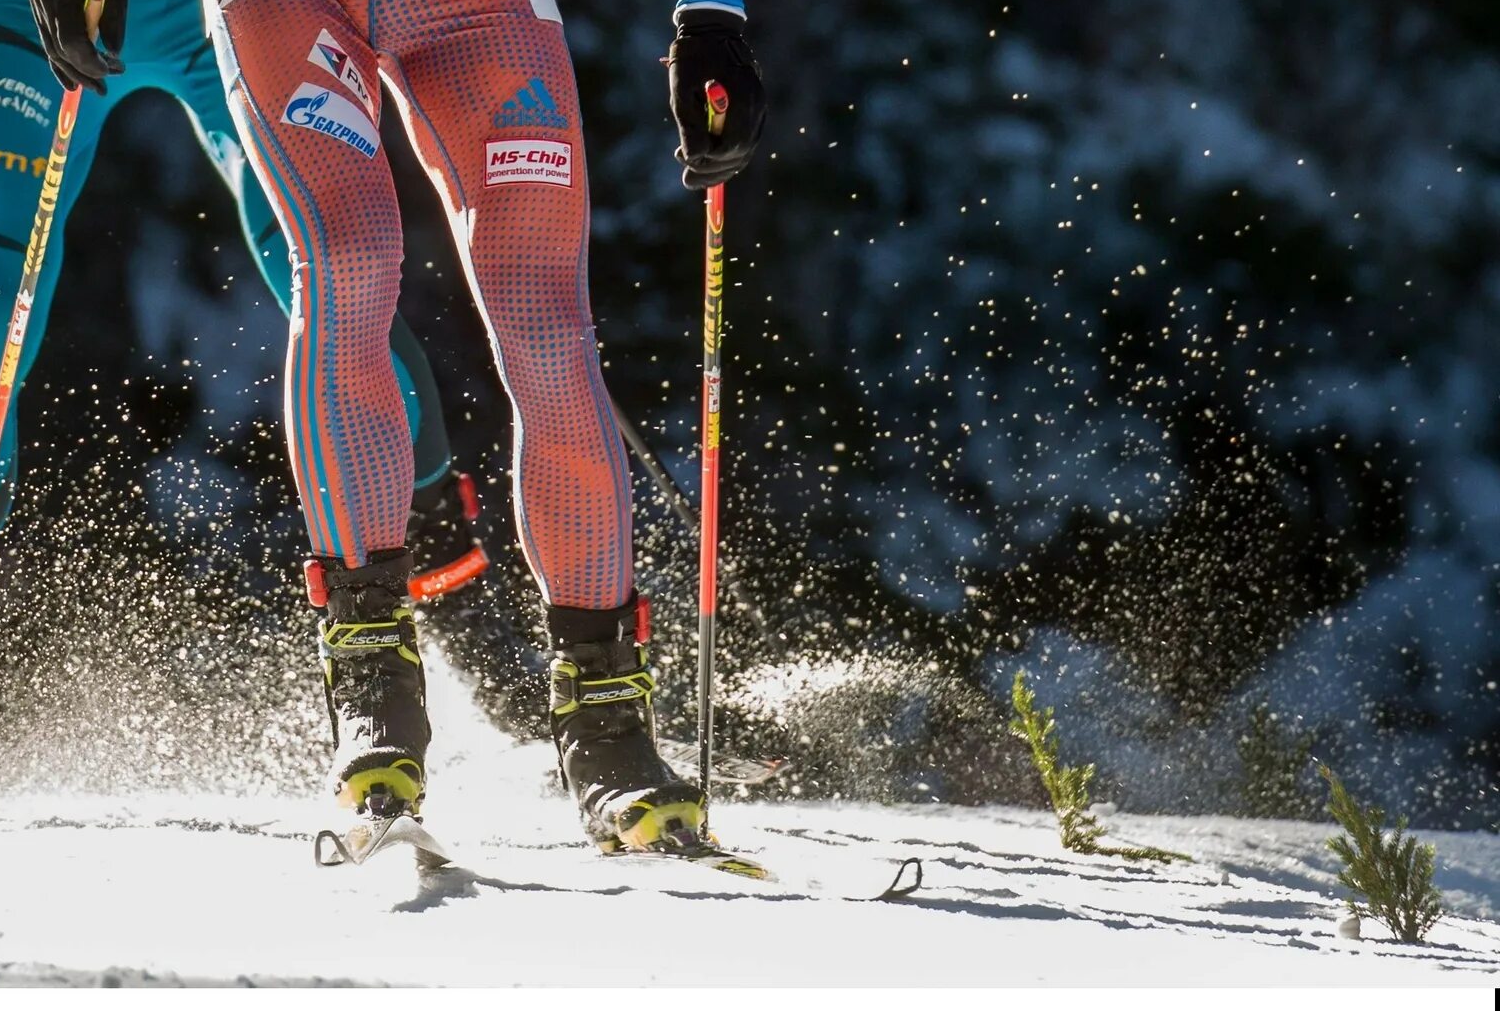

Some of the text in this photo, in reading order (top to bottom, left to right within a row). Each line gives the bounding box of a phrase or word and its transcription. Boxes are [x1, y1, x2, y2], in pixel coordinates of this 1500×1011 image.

[312, 115, 376, 158] GAZPROM
[487, 167, 570, 180] generation of power
[343, 634, 400, 645] FISCHER
[583, 687, 639, 701] FISCHER
